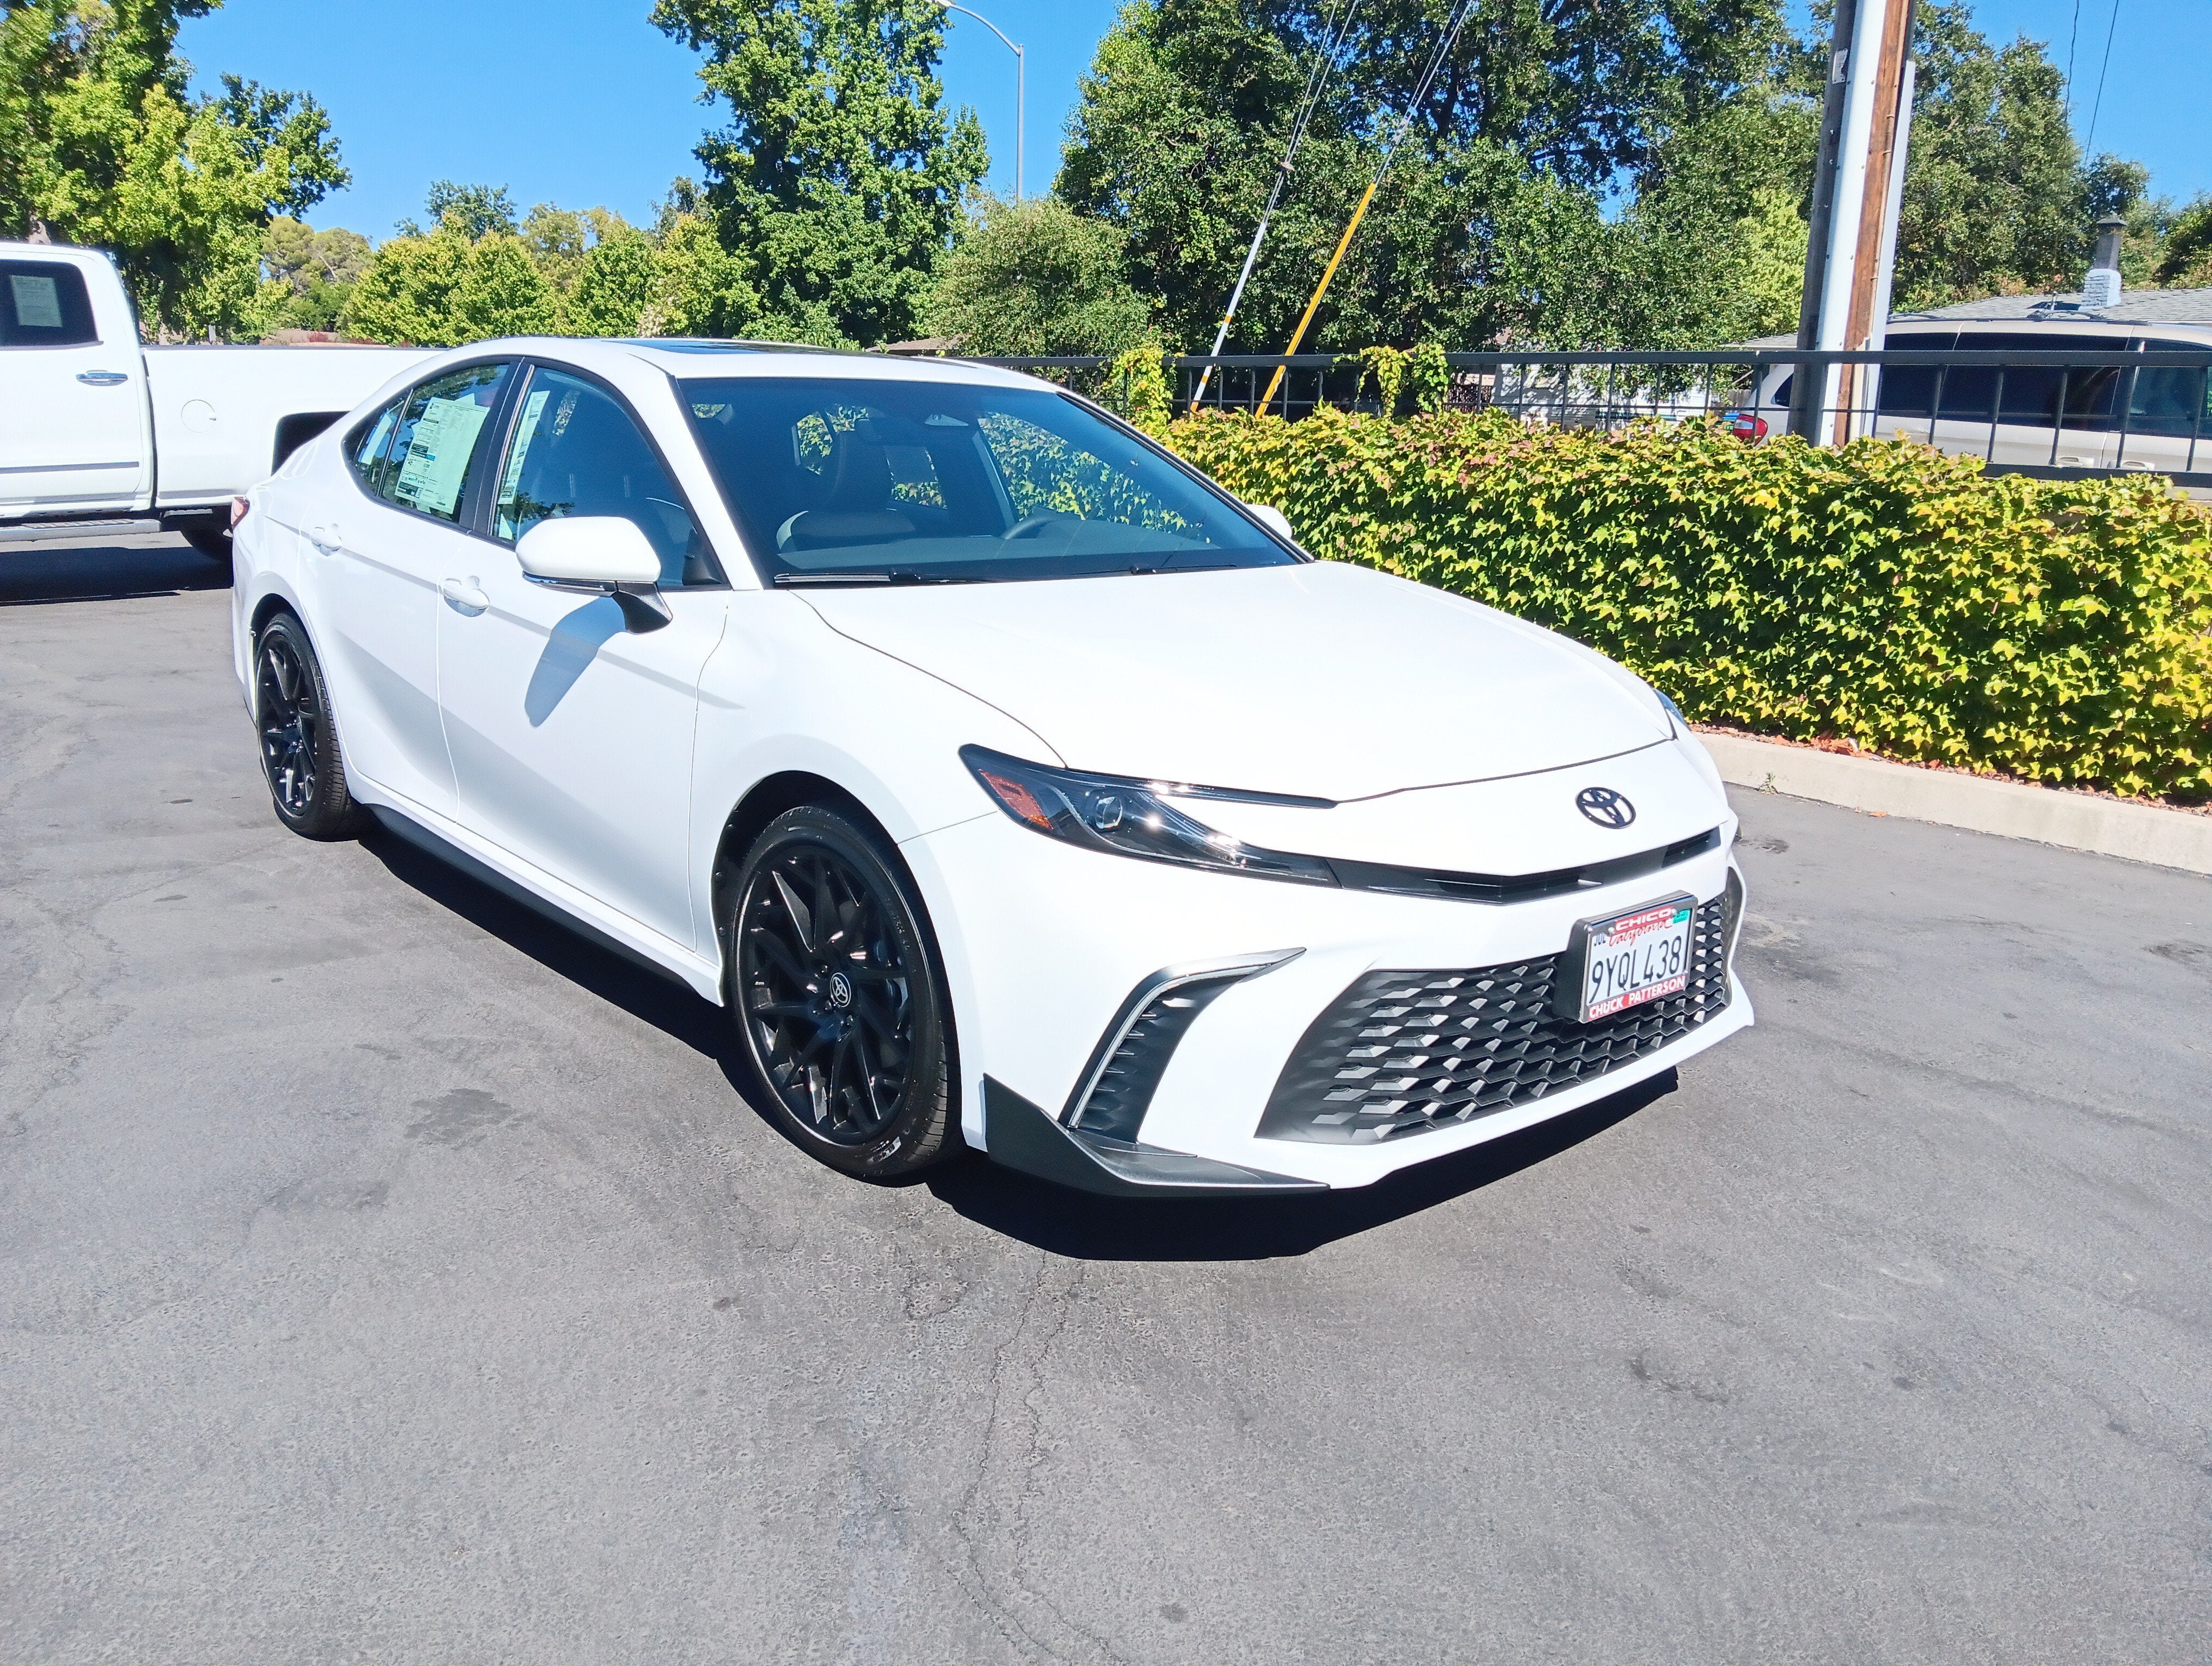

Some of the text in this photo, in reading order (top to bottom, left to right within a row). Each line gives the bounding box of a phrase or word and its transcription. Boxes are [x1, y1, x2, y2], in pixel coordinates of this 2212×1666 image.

[1616, 908, 1671, 931] CHICO
[1589, 935, 1682, 1003] 9YQL438
[1589, 976, 1685, 1018] CHUCK PATTERSON
